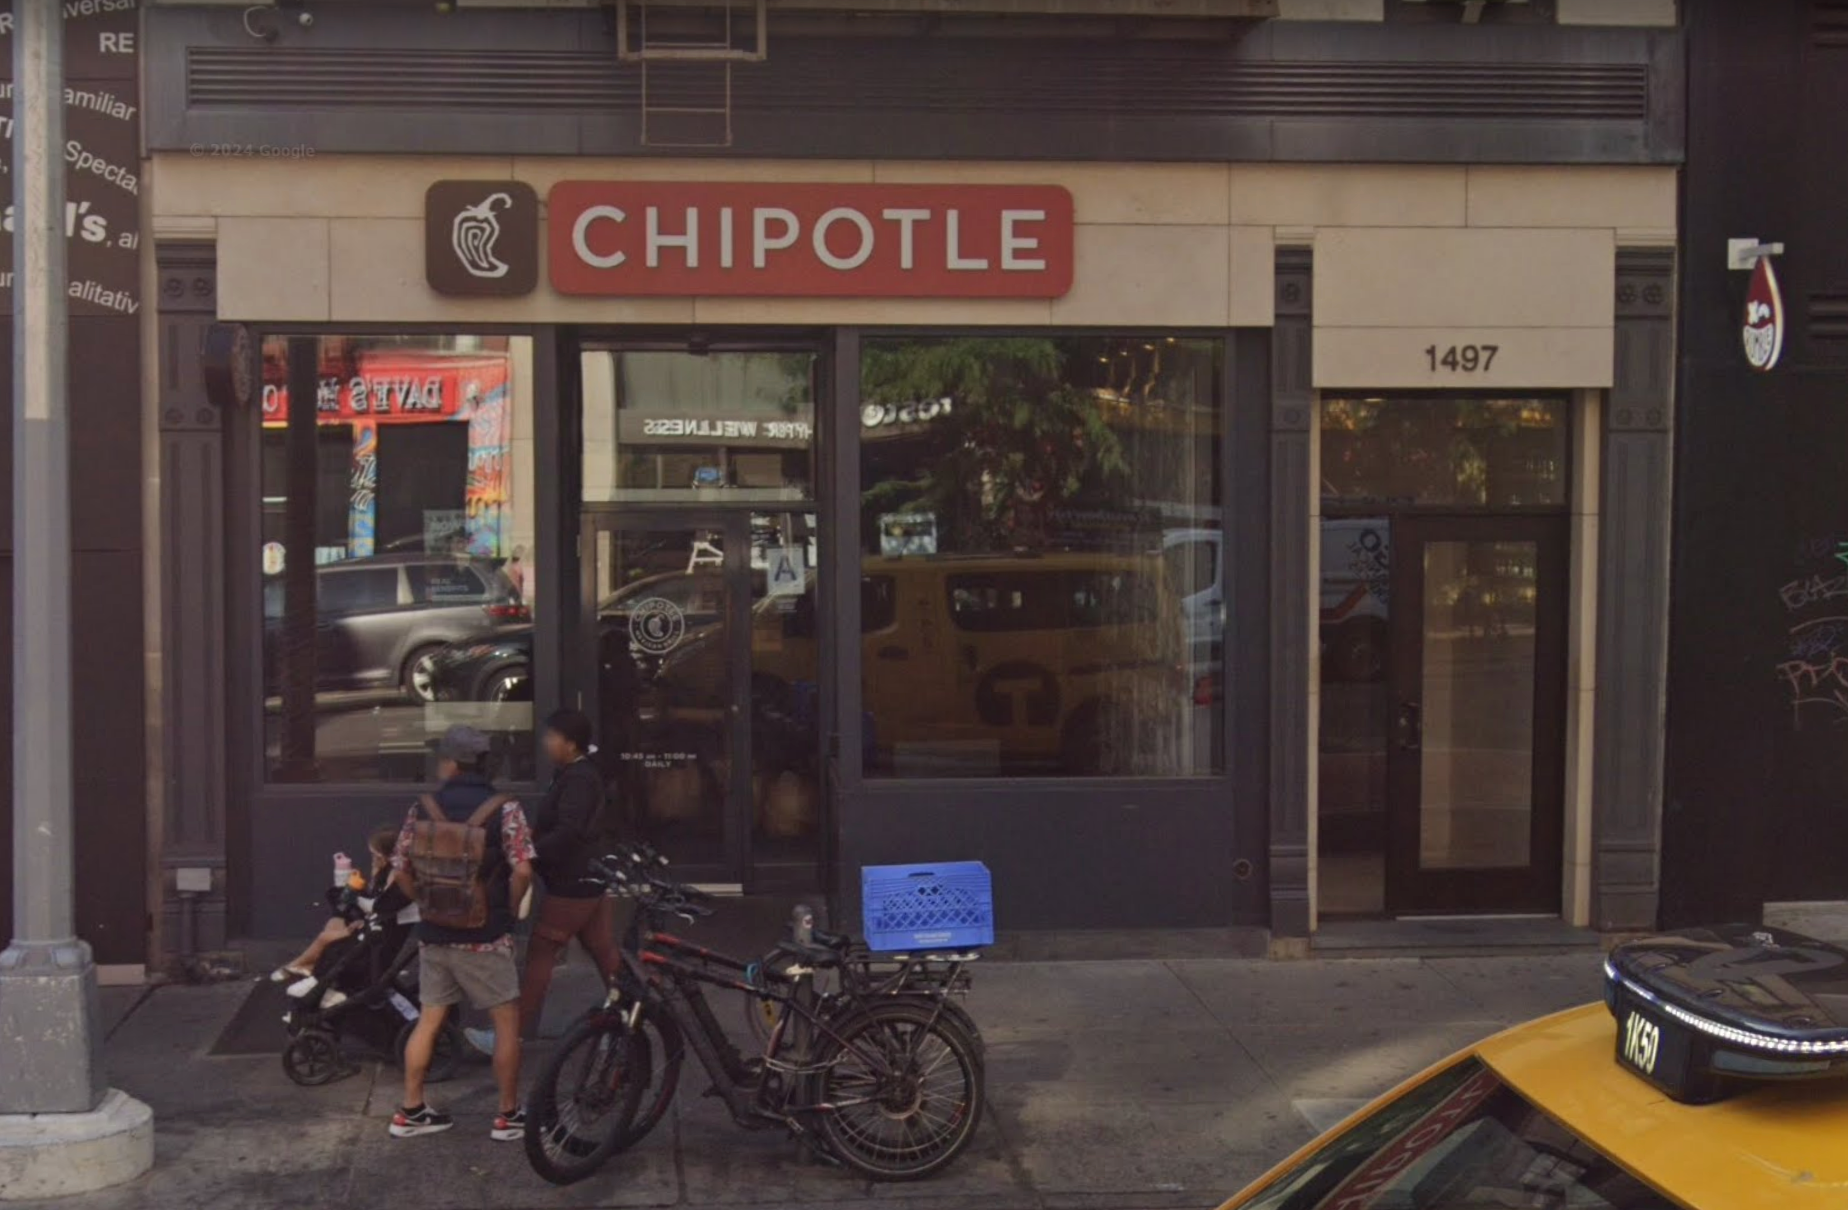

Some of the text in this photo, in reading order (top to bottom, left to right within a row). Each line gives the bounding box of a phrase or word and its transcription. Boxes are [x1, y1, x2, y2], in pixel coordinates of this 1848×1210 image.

[572, 205, 1046, 271] CHIPOTLE
[1424, 344, 1499, 372] 1497
[773, 555, 798, 582] A
[1624, 1011, 1660, 1075] 1K50
